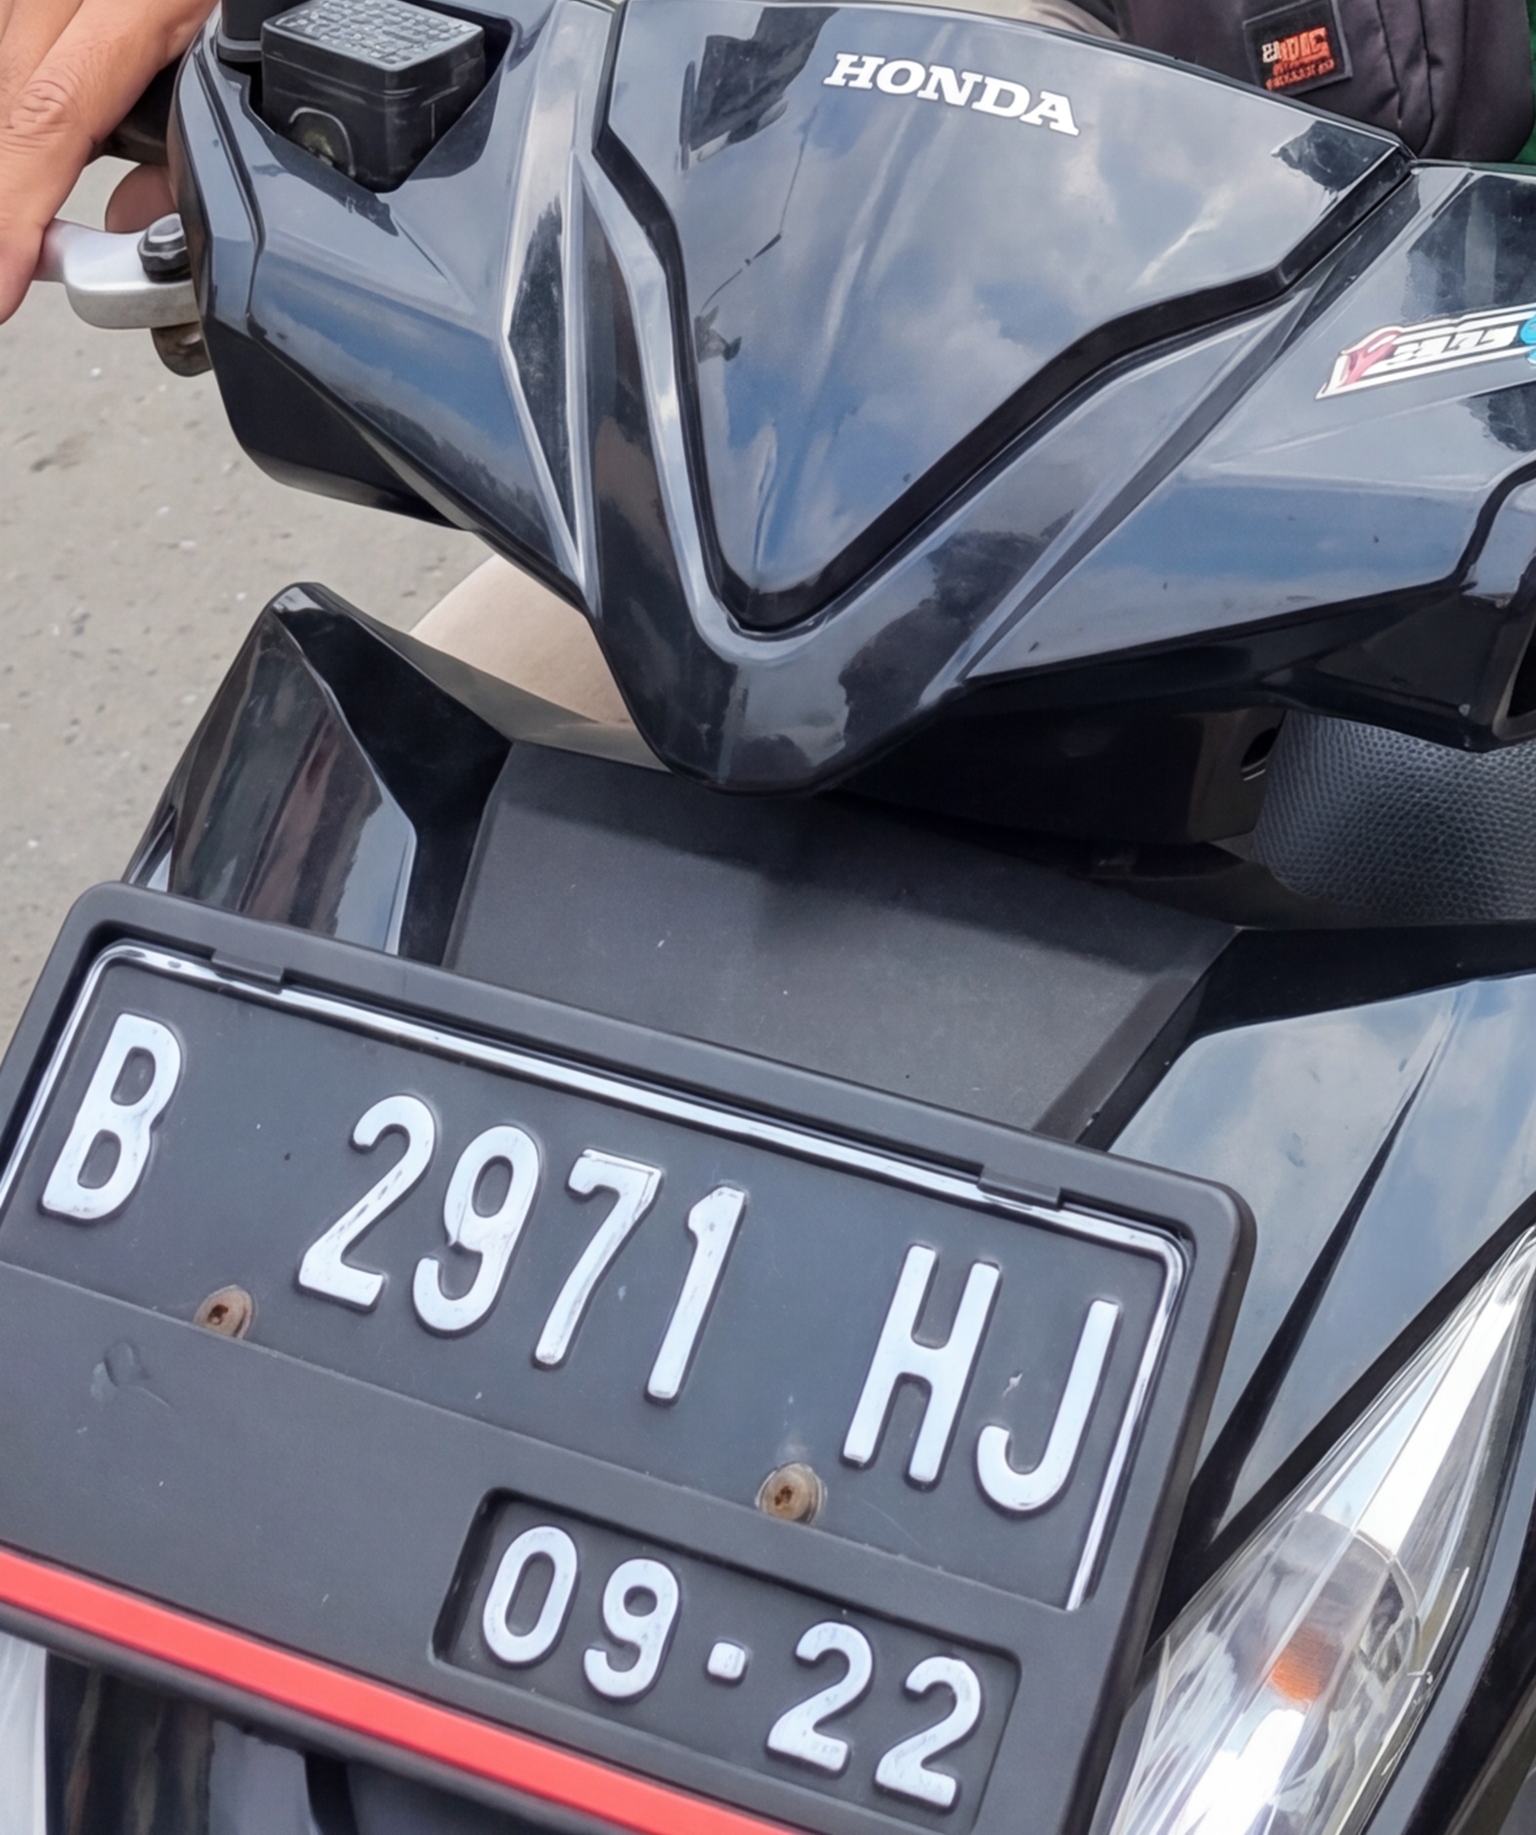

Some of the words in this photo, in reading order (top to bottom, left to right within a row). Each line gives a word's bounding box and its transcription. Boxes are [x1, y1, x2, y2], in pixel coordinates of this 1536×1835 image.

[823, 52, 1080, 137] HONDA
[41, 1013, 183, 1223] B
[298, 1095, 748, 1402] 2971
[843, 1244, 1120, 1513] HJ
